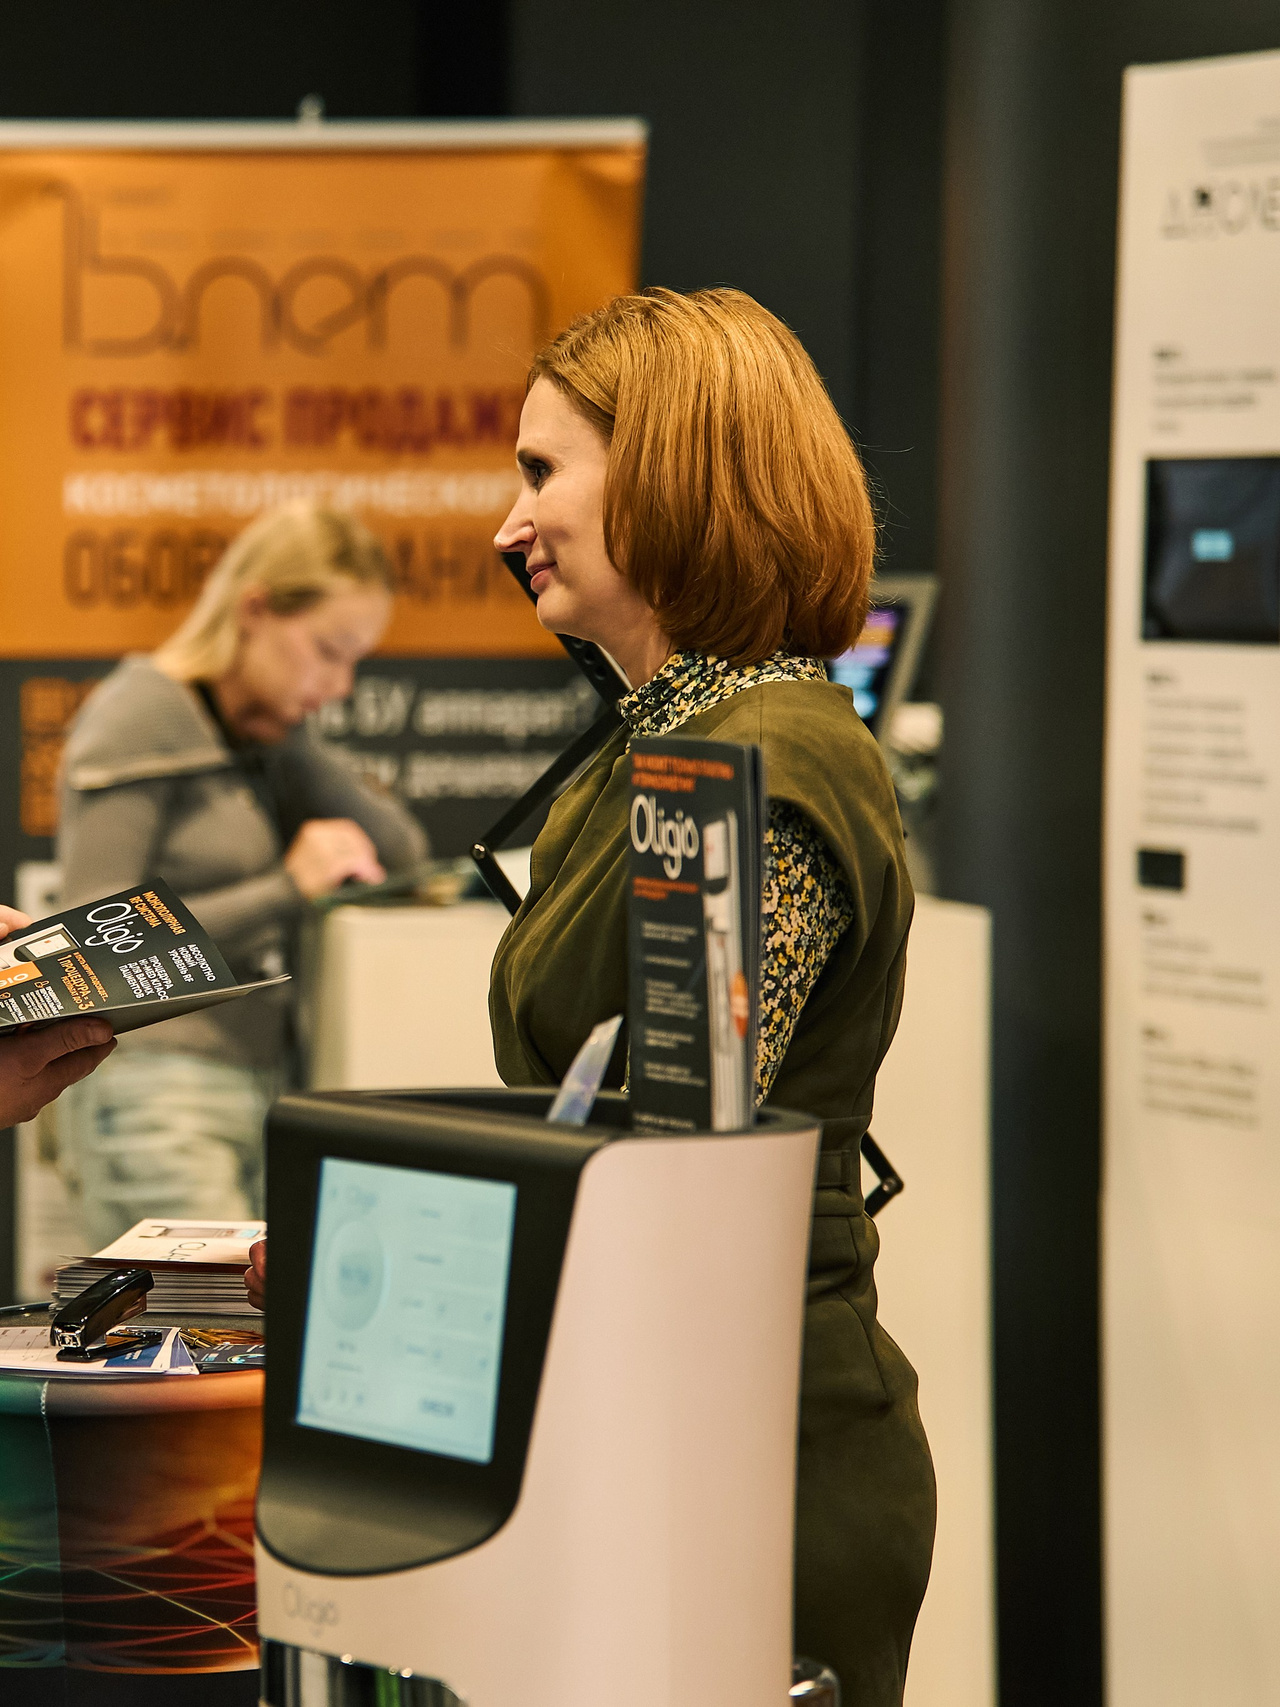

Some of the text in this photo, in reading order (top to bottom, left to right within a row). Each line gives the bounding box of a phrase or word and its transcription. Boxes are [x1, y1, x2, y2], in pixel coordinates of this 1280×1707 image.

[71, 385, 524, 455] СЕРВИС ПРОДАЖ
[630, 794, 700, 880] Oligio
[84, 902, 145, 954] Oligio
[128, 895, 162, 928] RF СИСТЕМА
[143, 891, 186, 935] МОНОПОЛЯРНАЯ
[57, 954, 72, 962] 1
[148, 955, 174, 990] ПРОЦЕДУРА
[168, 949, 194, 983] УРОВЕНЬ RF
[178, 946, 197, 968] НОВЫЙ
[187, 944, 216, 982] АБСОЛЮТНО
[60, 959, 91, 997] ПРОЦЕДУРА
[119, 964, 145, 999] ПАЦИЕНТОВ
[127, 962, 155, 996] ДЛЯ ВАШИХ
[78, 1000, 95, 1011] 3
